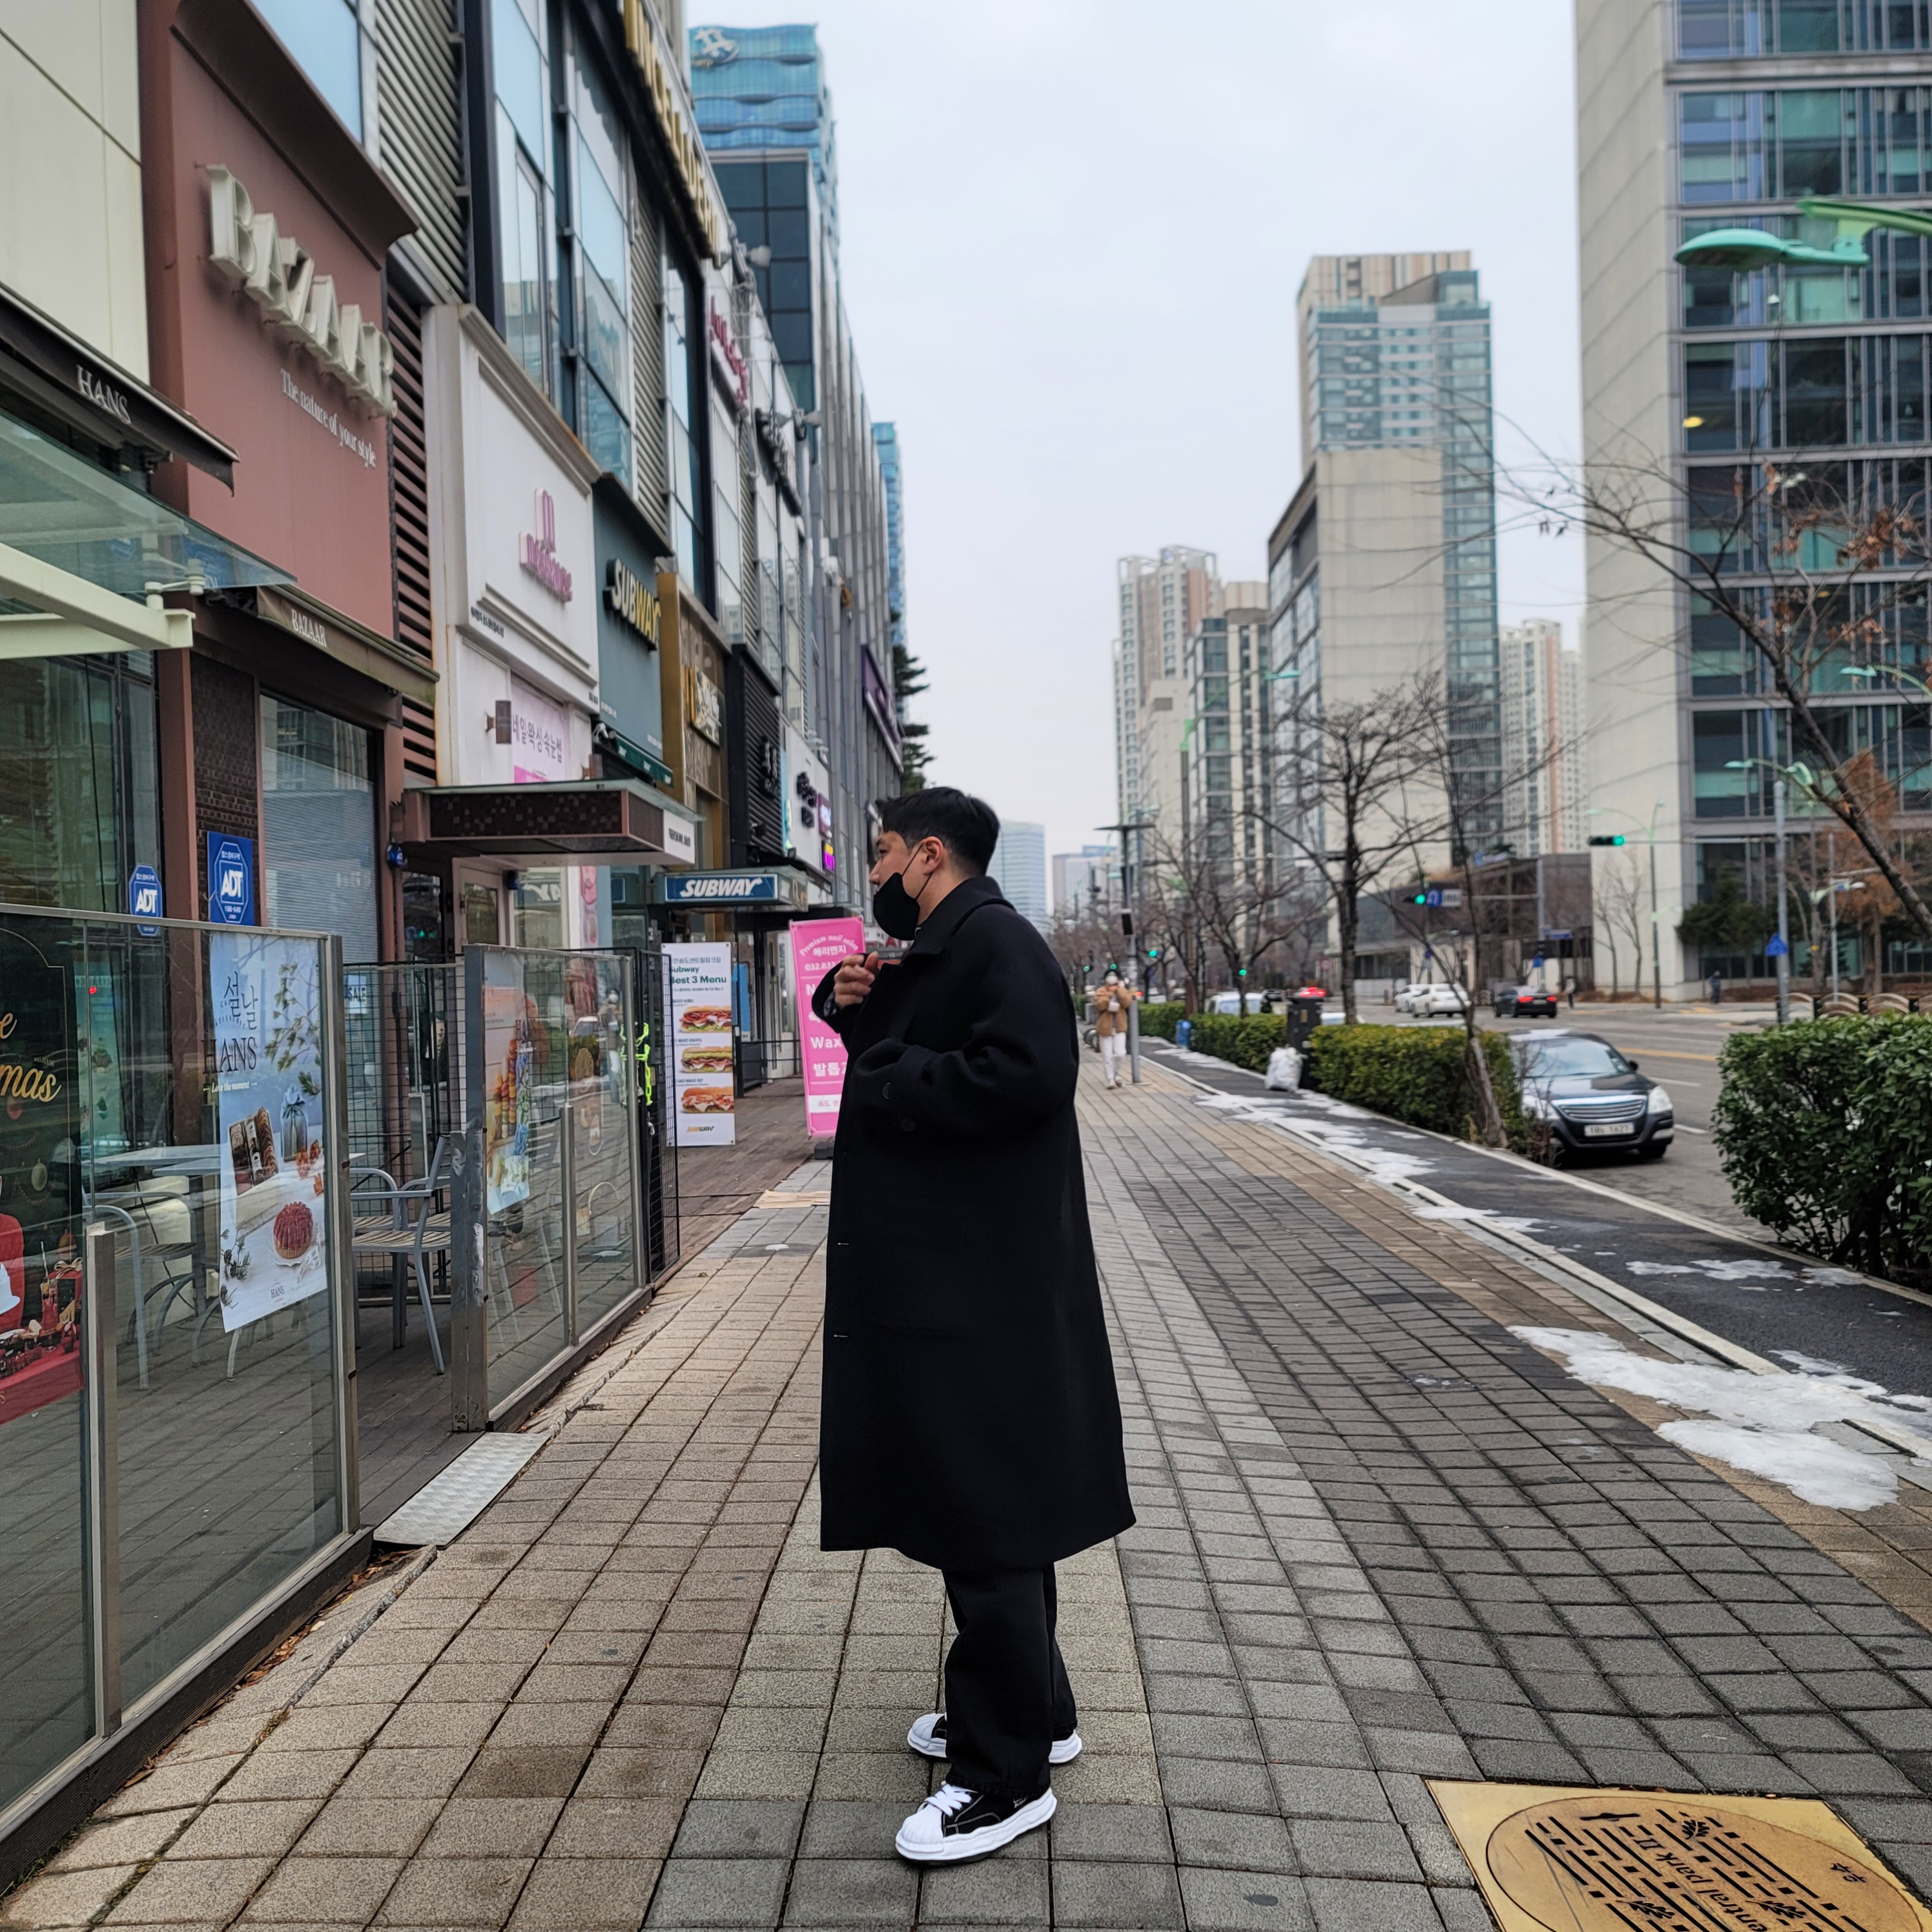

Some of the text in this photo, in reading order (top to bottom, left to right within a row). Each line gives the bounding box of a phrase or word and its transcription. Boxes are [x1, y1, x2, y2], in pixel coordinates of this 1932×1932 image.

[206, 163, 398, 418] BAZAAR
[76, 364, 131, 424] HANS
[280, 367, 376, 468] The nature of your style
[604, 557, 661, 648] SUBWAY
[291, 608, 327, 647] BAZAAR
[135, 888, 158, 914] ADT
[220, 869, 243, 899] ADT
[680, 878, 763, 898] SUBWAY
[223, 971, 258, 1031] 설날
[201, 1036, 258, 1074] HANS
[211, 1082, 223, 1093] Love
[231, 1080, 250, 1091] moment
[1696, 1889, 1768, 1932] entral
